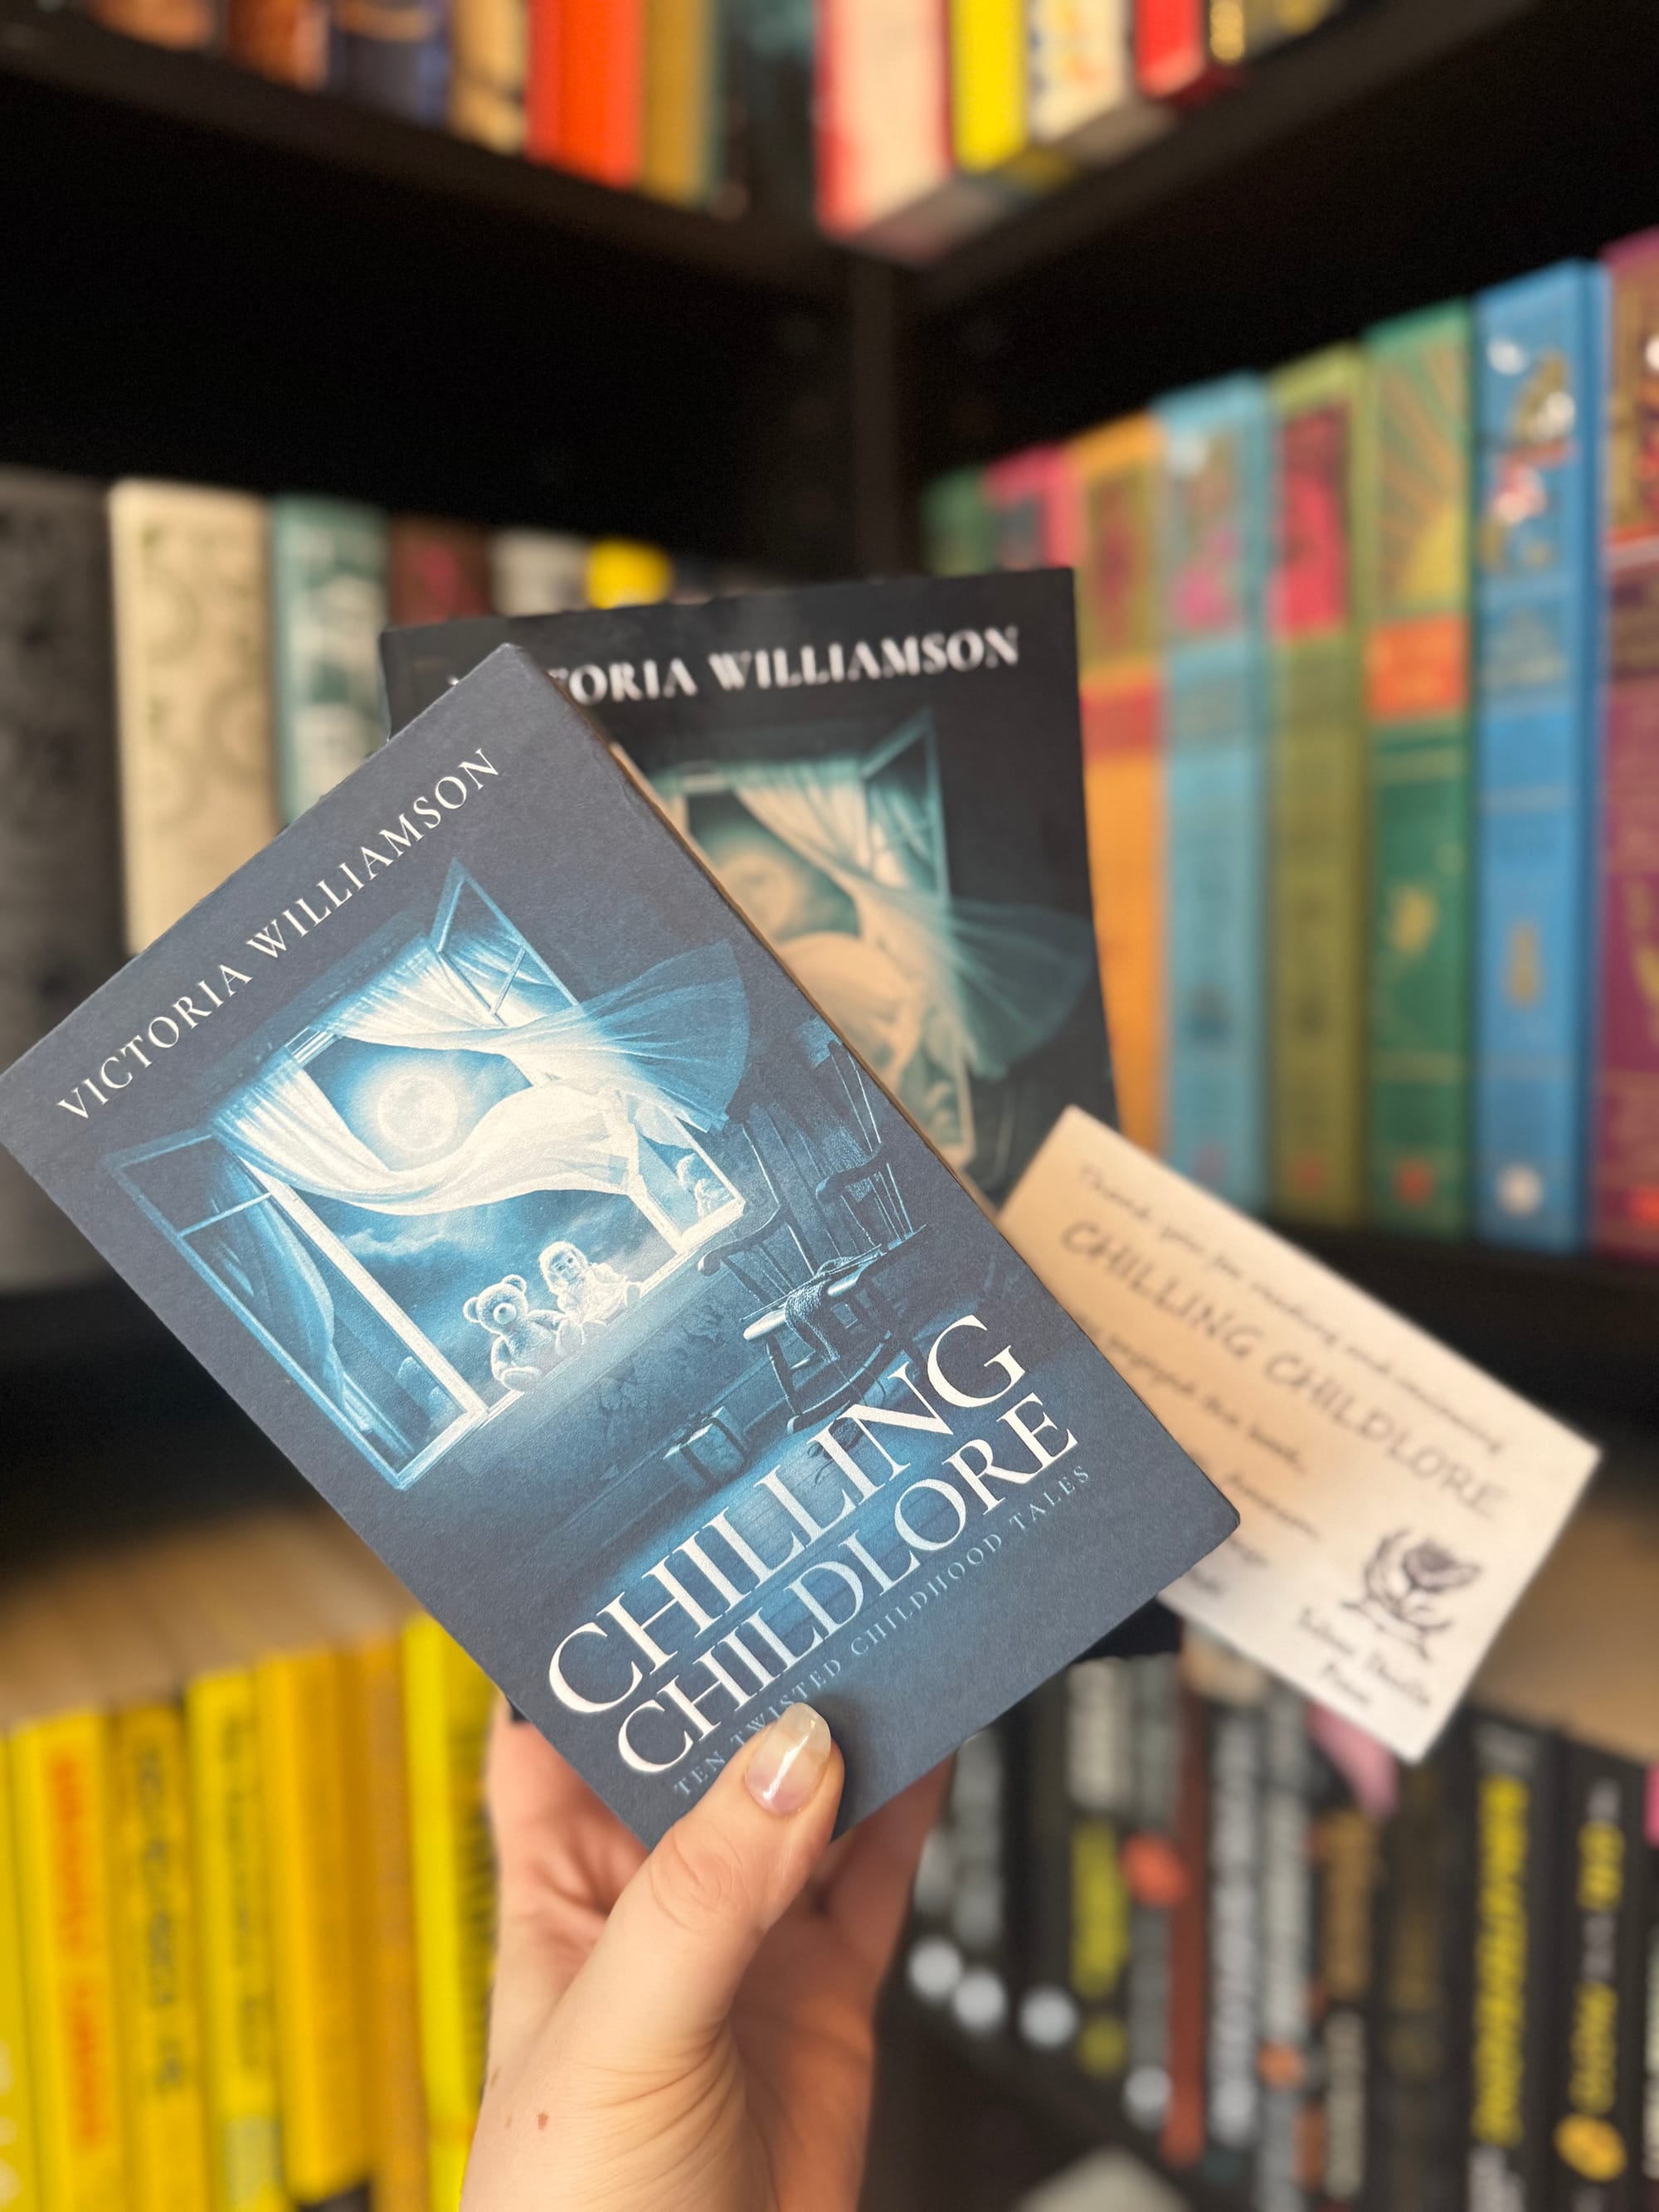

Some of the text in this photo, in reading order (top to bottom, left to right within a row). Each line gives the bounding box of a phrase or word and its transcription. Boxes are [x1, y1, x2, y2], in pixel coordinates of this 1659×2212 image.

[708, 625, 1021, 691] WILLIAMSON
[56, 748, 499, 1122] VICTORIA WILLIAMSON
[1060, 1218, 1265, 1362] CHILLING
[1262, 1350, 1510, 1521] CHILDLORE
[549, 1314, 1078, 1773] CHILLING CHILDLORE
[674, 1464, 1091, 1796] TEN TWISTED CHILDHOOD TALES
